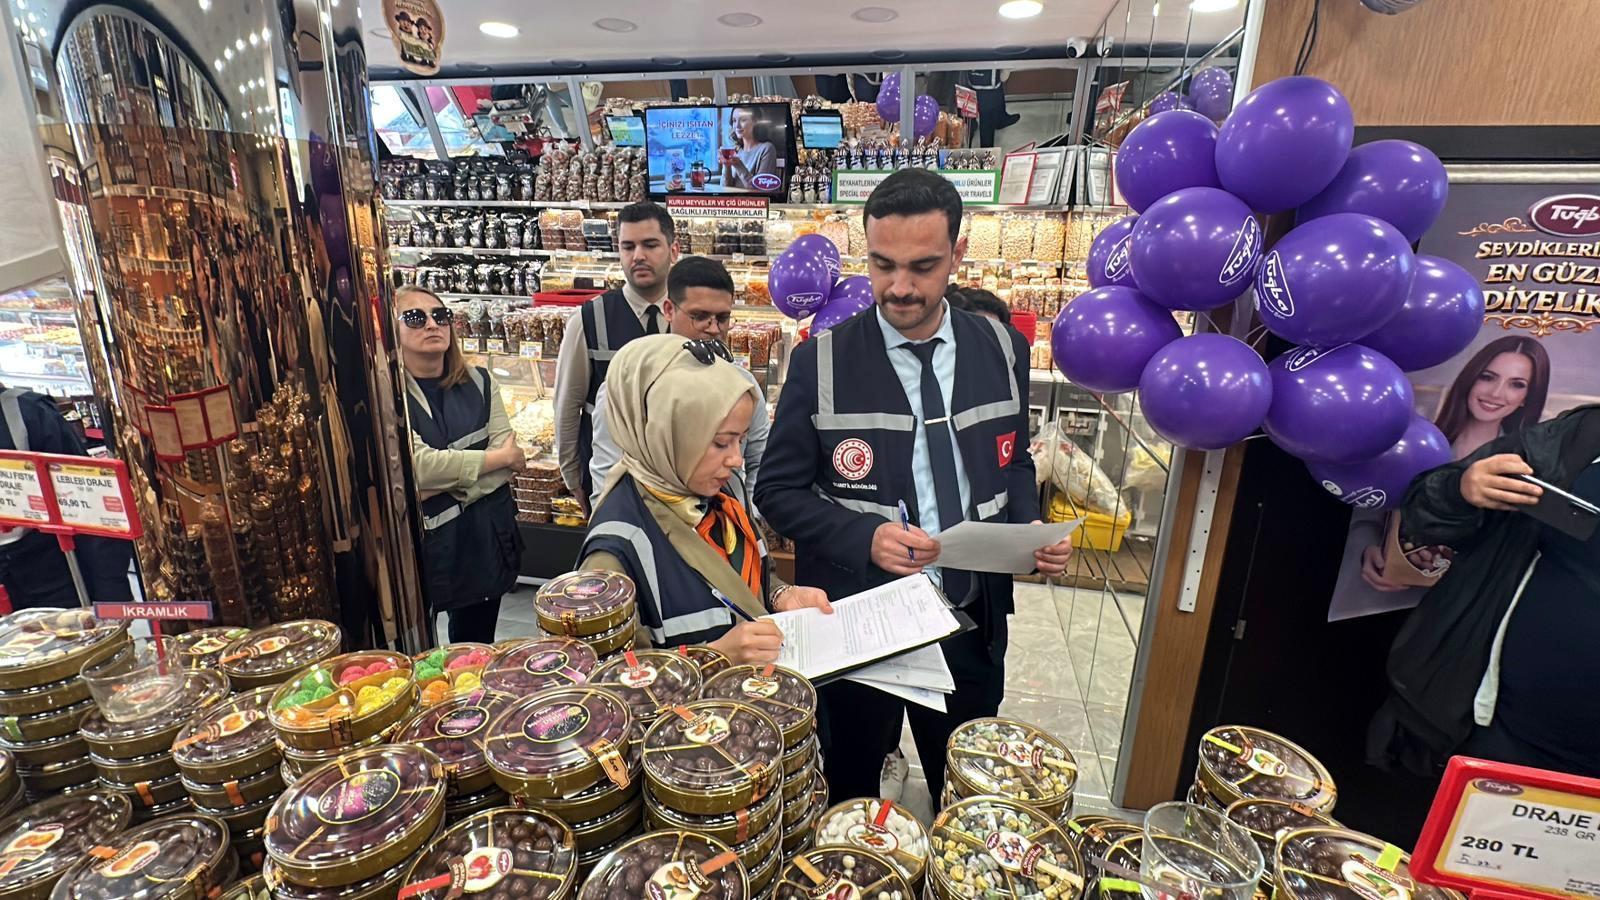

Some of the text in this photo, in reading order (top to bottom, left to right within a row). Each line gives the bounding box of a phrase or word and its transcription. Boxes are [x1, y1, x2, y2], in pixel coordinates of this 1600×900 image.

[737, 199, 766, 207] ÜRÜNLER
[671, 207, 763, 217] SAĞLIKLI ATIŞTIRMALIKLAR
[1484, 264, 1528, 283] EN
[86, 477, 113, 488] DRAJE
[6, 498, 16, 507] TL
[80, 499, 92, 509] TL
[122, 605, 188, 617] İKRAMLIK
[1512, 804, 1592, 829] DRAJE
[1544, 825, 1596, 841] 238 GR
[1461, 836, 1539, 859] 280 TL
